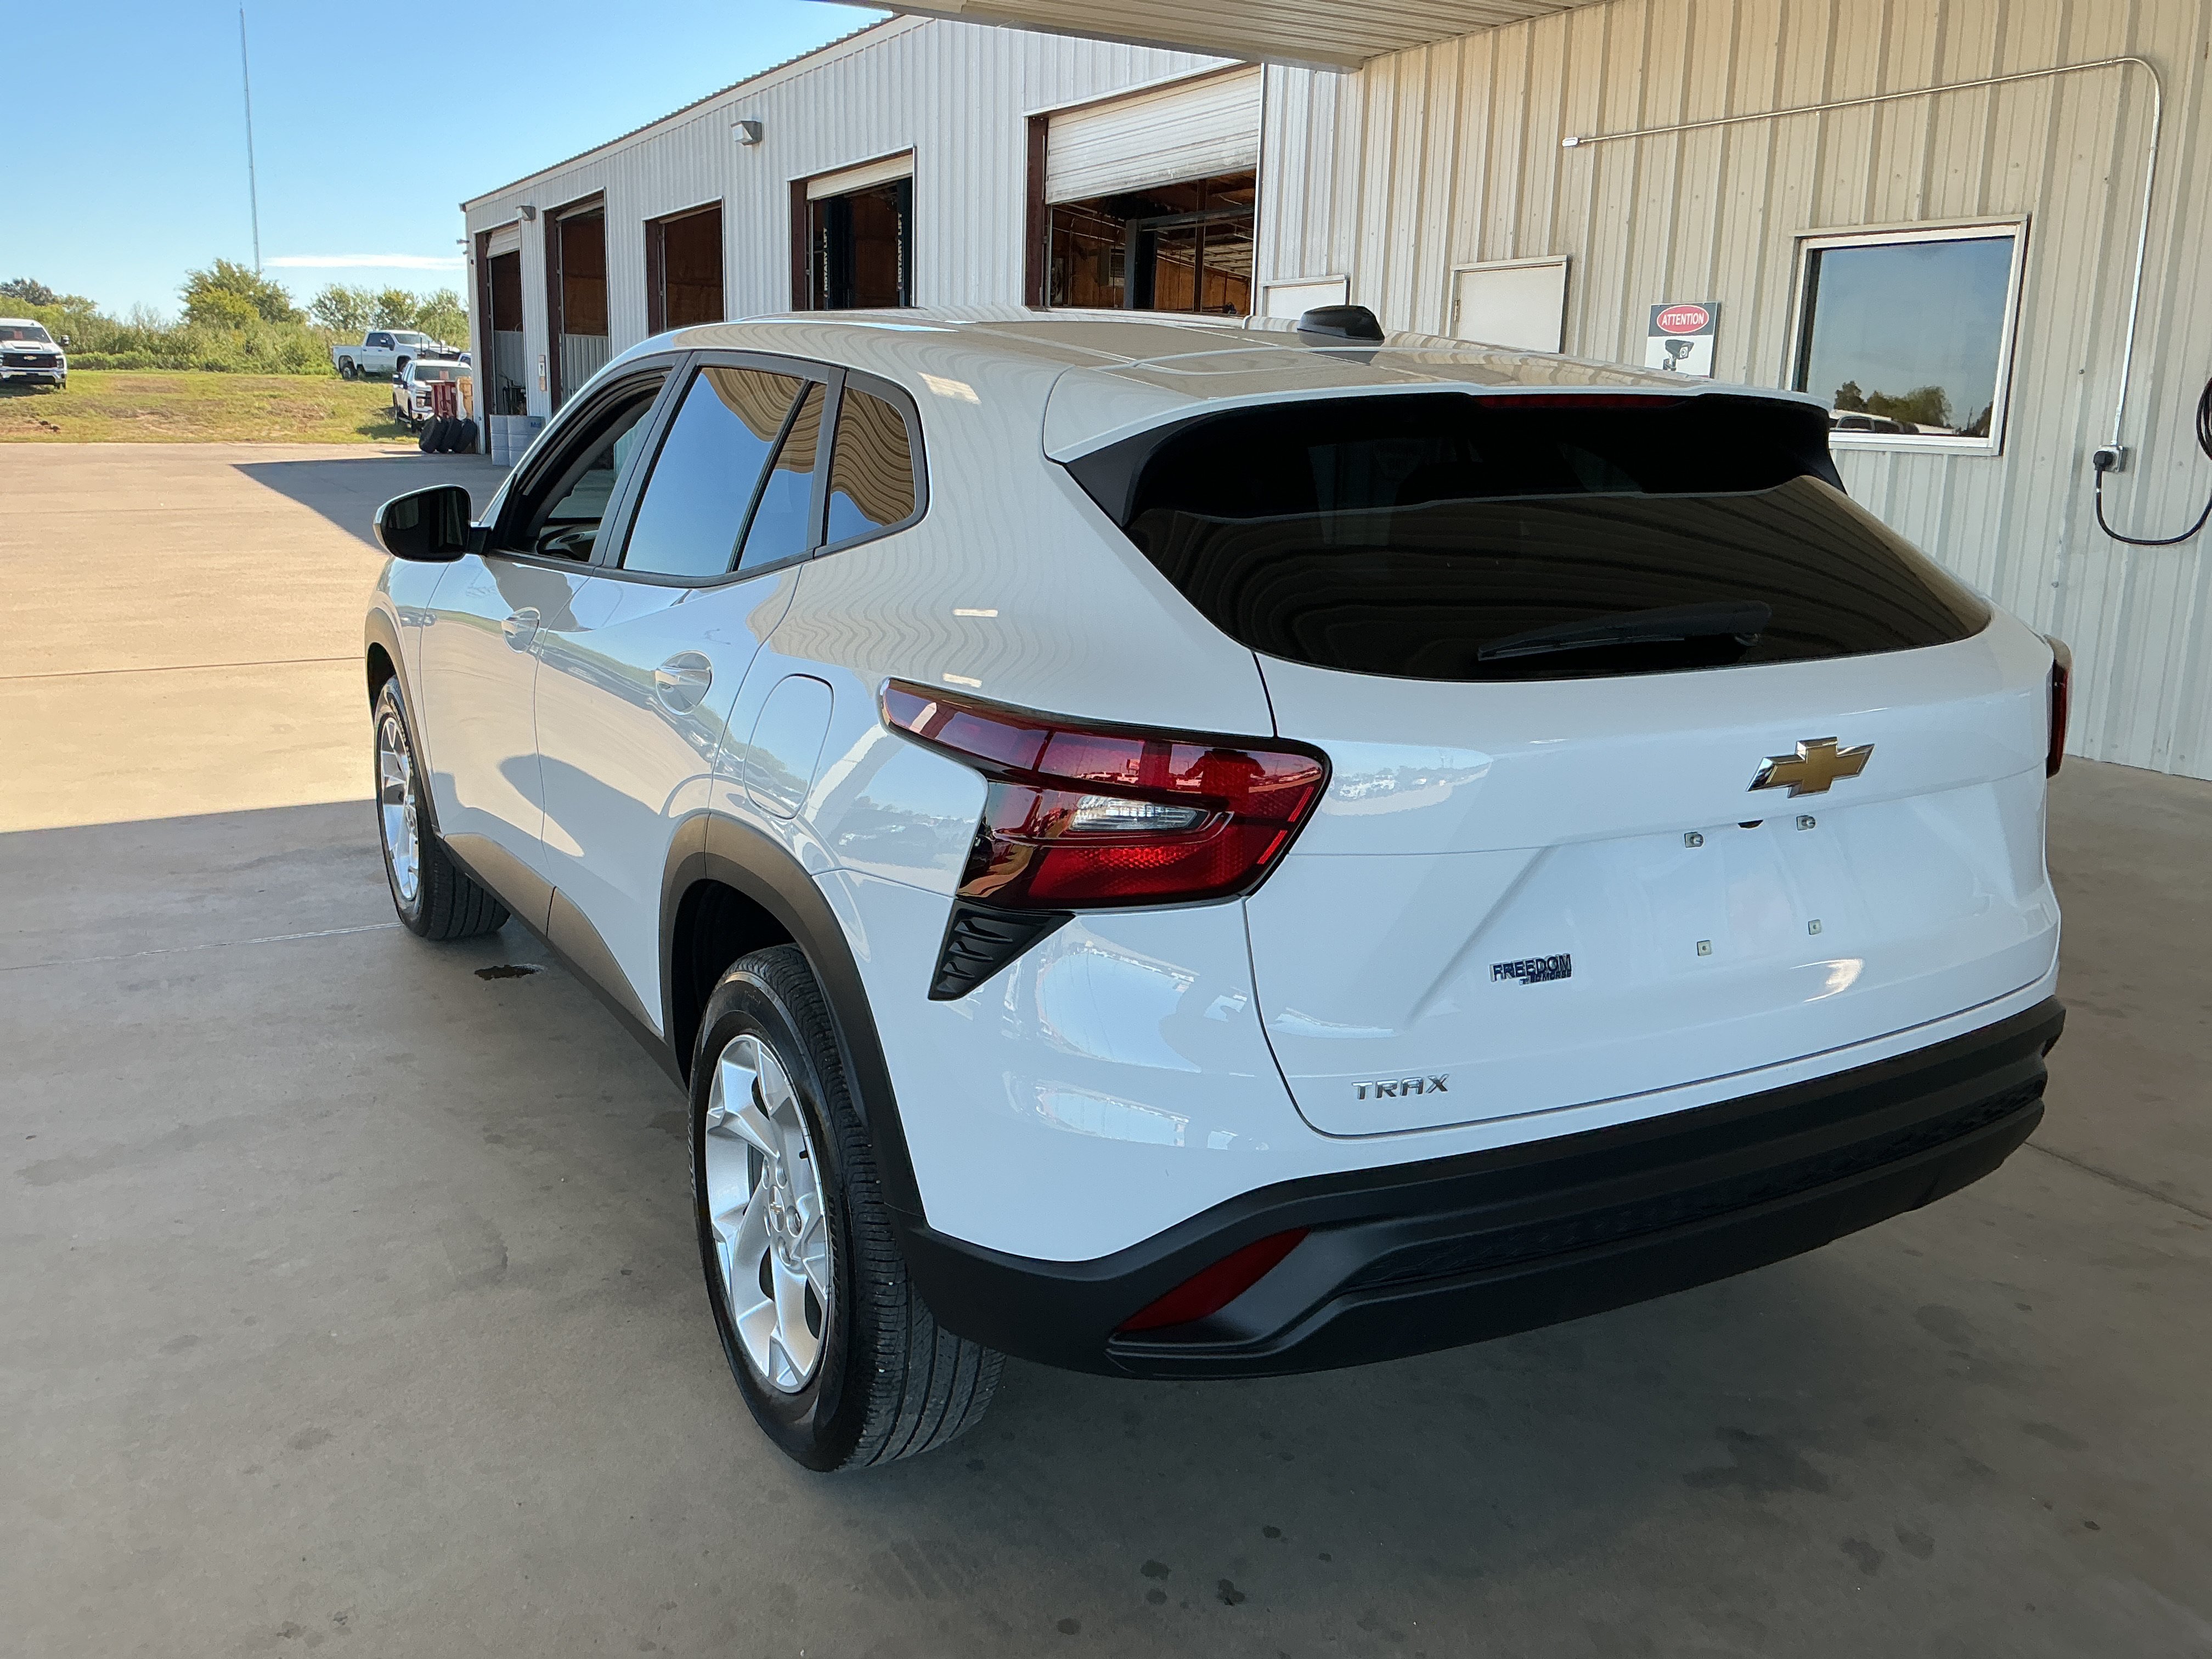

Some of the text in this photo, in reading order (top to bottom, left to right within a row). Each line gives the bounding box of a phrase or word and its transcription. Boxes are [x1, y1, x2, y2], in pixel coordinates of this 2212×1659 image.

[1661, 312, 1705, 326] ATTENTION
[1489, 953, 1572, 982] FREEDOM
[1351, 1073, 1449, 1100] TRAX
